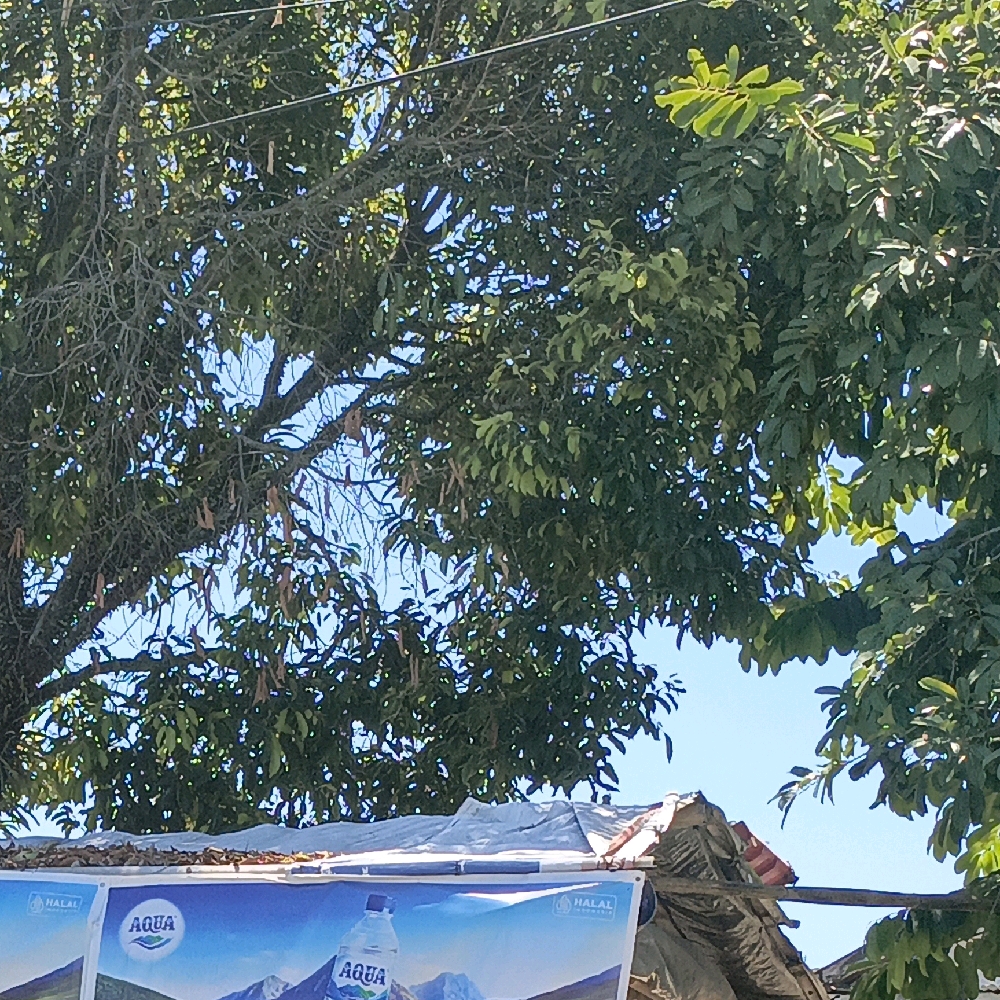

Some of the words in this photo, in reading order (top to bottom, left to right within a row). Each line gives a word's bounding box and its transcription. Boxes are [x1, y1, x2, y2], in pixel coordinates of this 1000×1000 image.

[574, 898, 613, 910] HALAL
[128, 915, 176, 933] AQUA
[338, 961, 387, 986] AQUA
